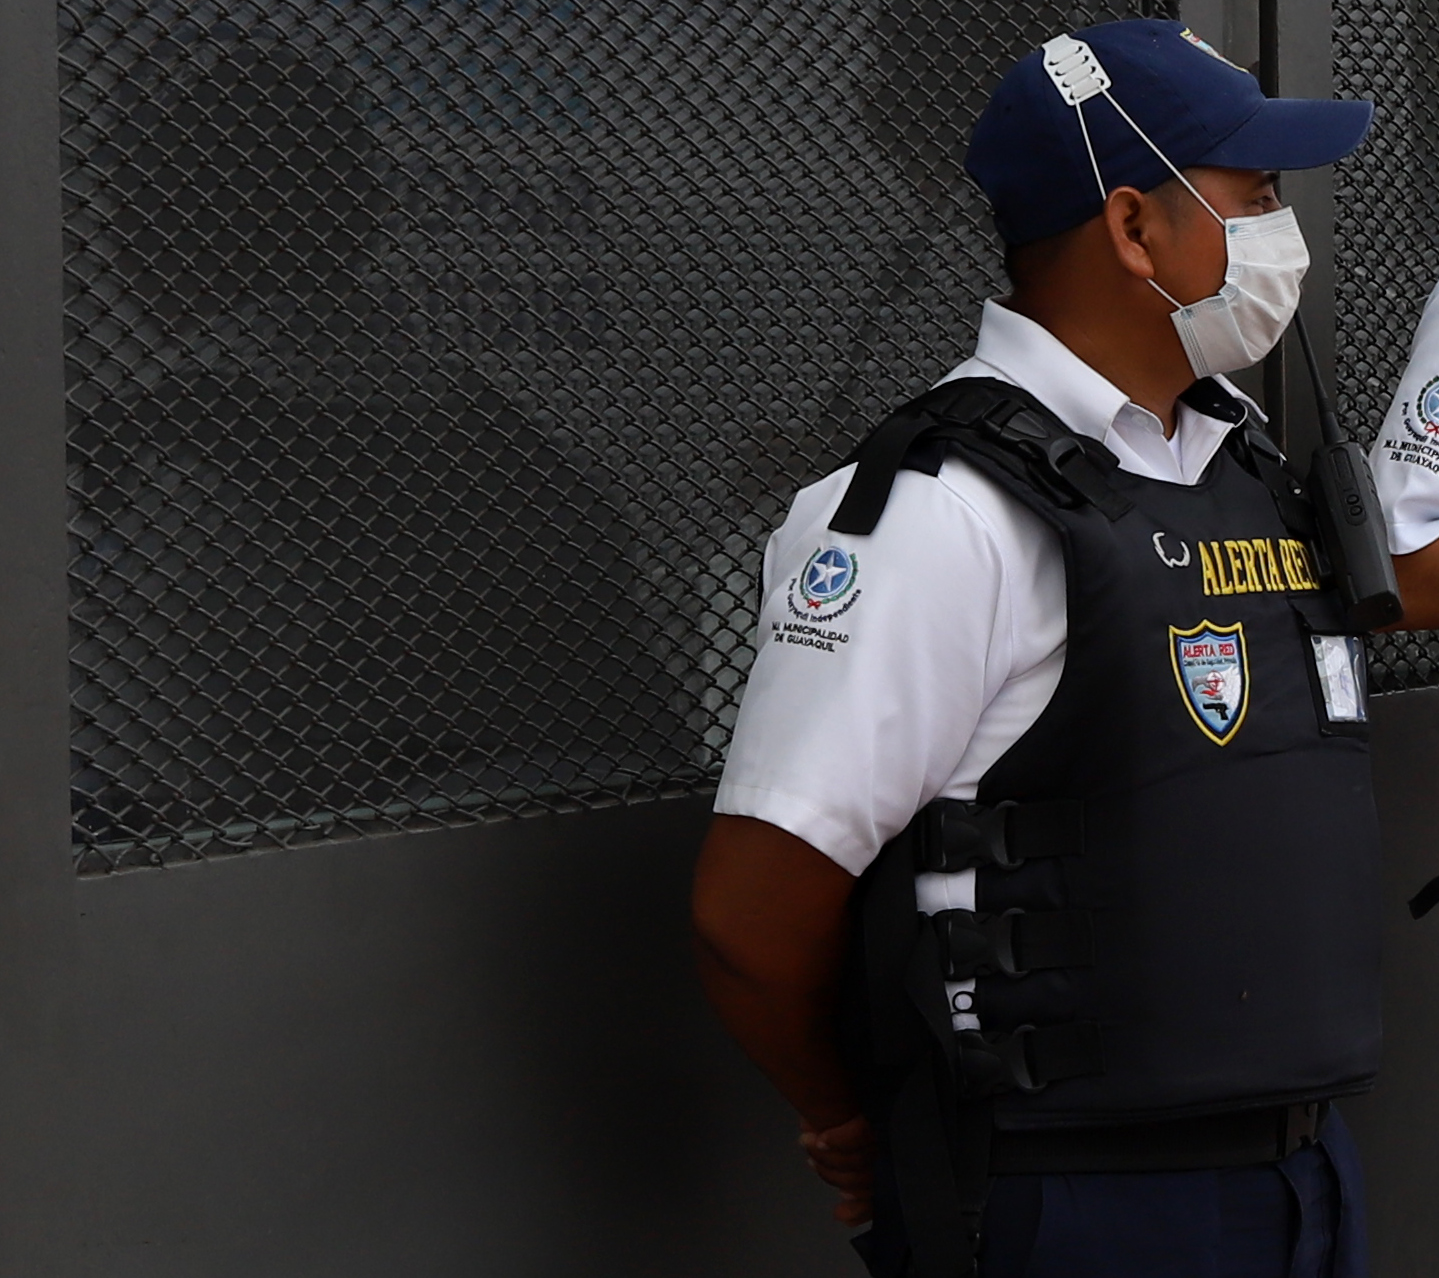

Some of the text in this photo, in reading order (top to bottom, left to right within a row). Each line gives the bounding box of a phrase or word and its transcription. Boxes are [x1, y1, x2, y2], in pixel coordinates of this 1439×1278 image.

[1198, 538, 1285, 596] ALERTA
[784, 623, 849, 643] MUNICIPALIDAD
[787, 635, 835, 652] GUAYAQUIL
[1183, 643, 1216, 658] ALERTA
